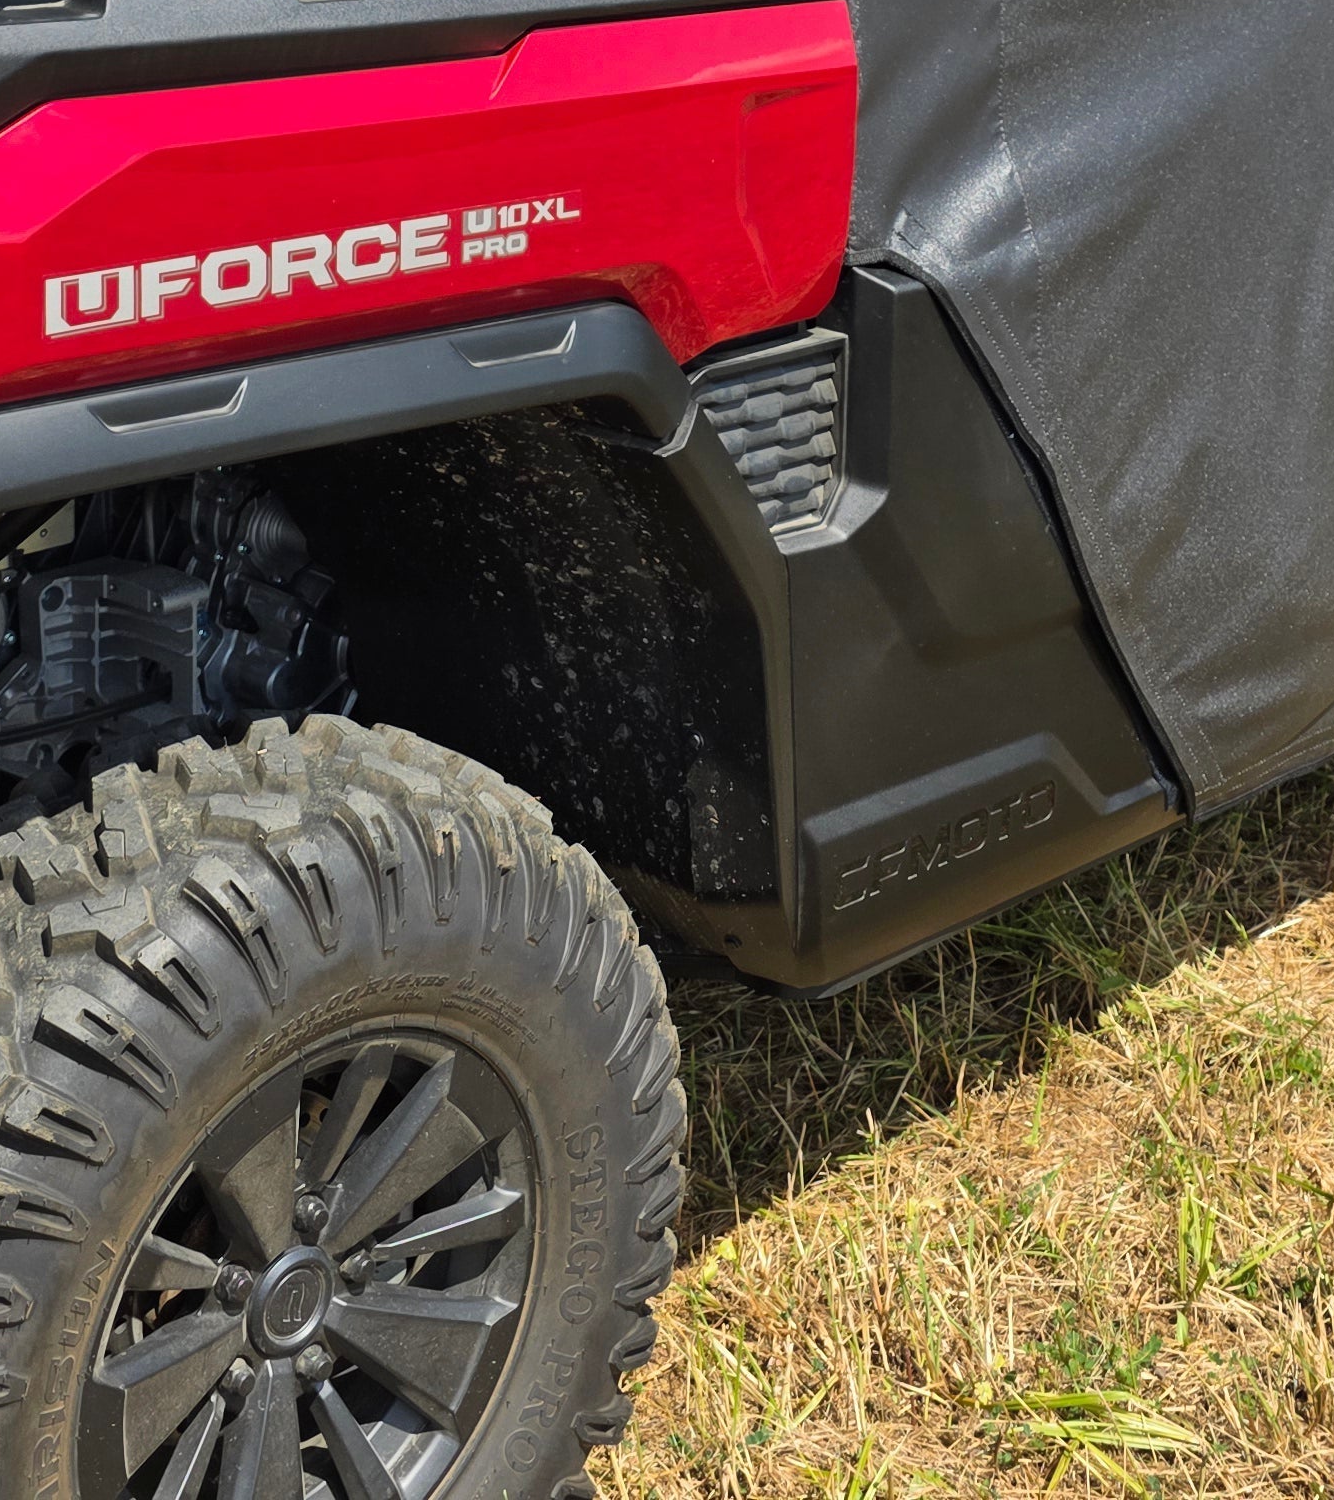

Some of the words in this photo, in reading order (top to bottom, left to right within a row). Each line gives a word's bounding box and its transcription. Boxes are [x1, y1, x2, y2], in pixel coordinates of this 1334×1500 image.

[44, 214, 451, 338] UFORCE
[462, 230, 529, 265] PRO
[833, 779, 1057, 911] CFMOTO
[558, 1123, 609, 1326] STEGO
[503, 1340, 585, 1474] PRO
